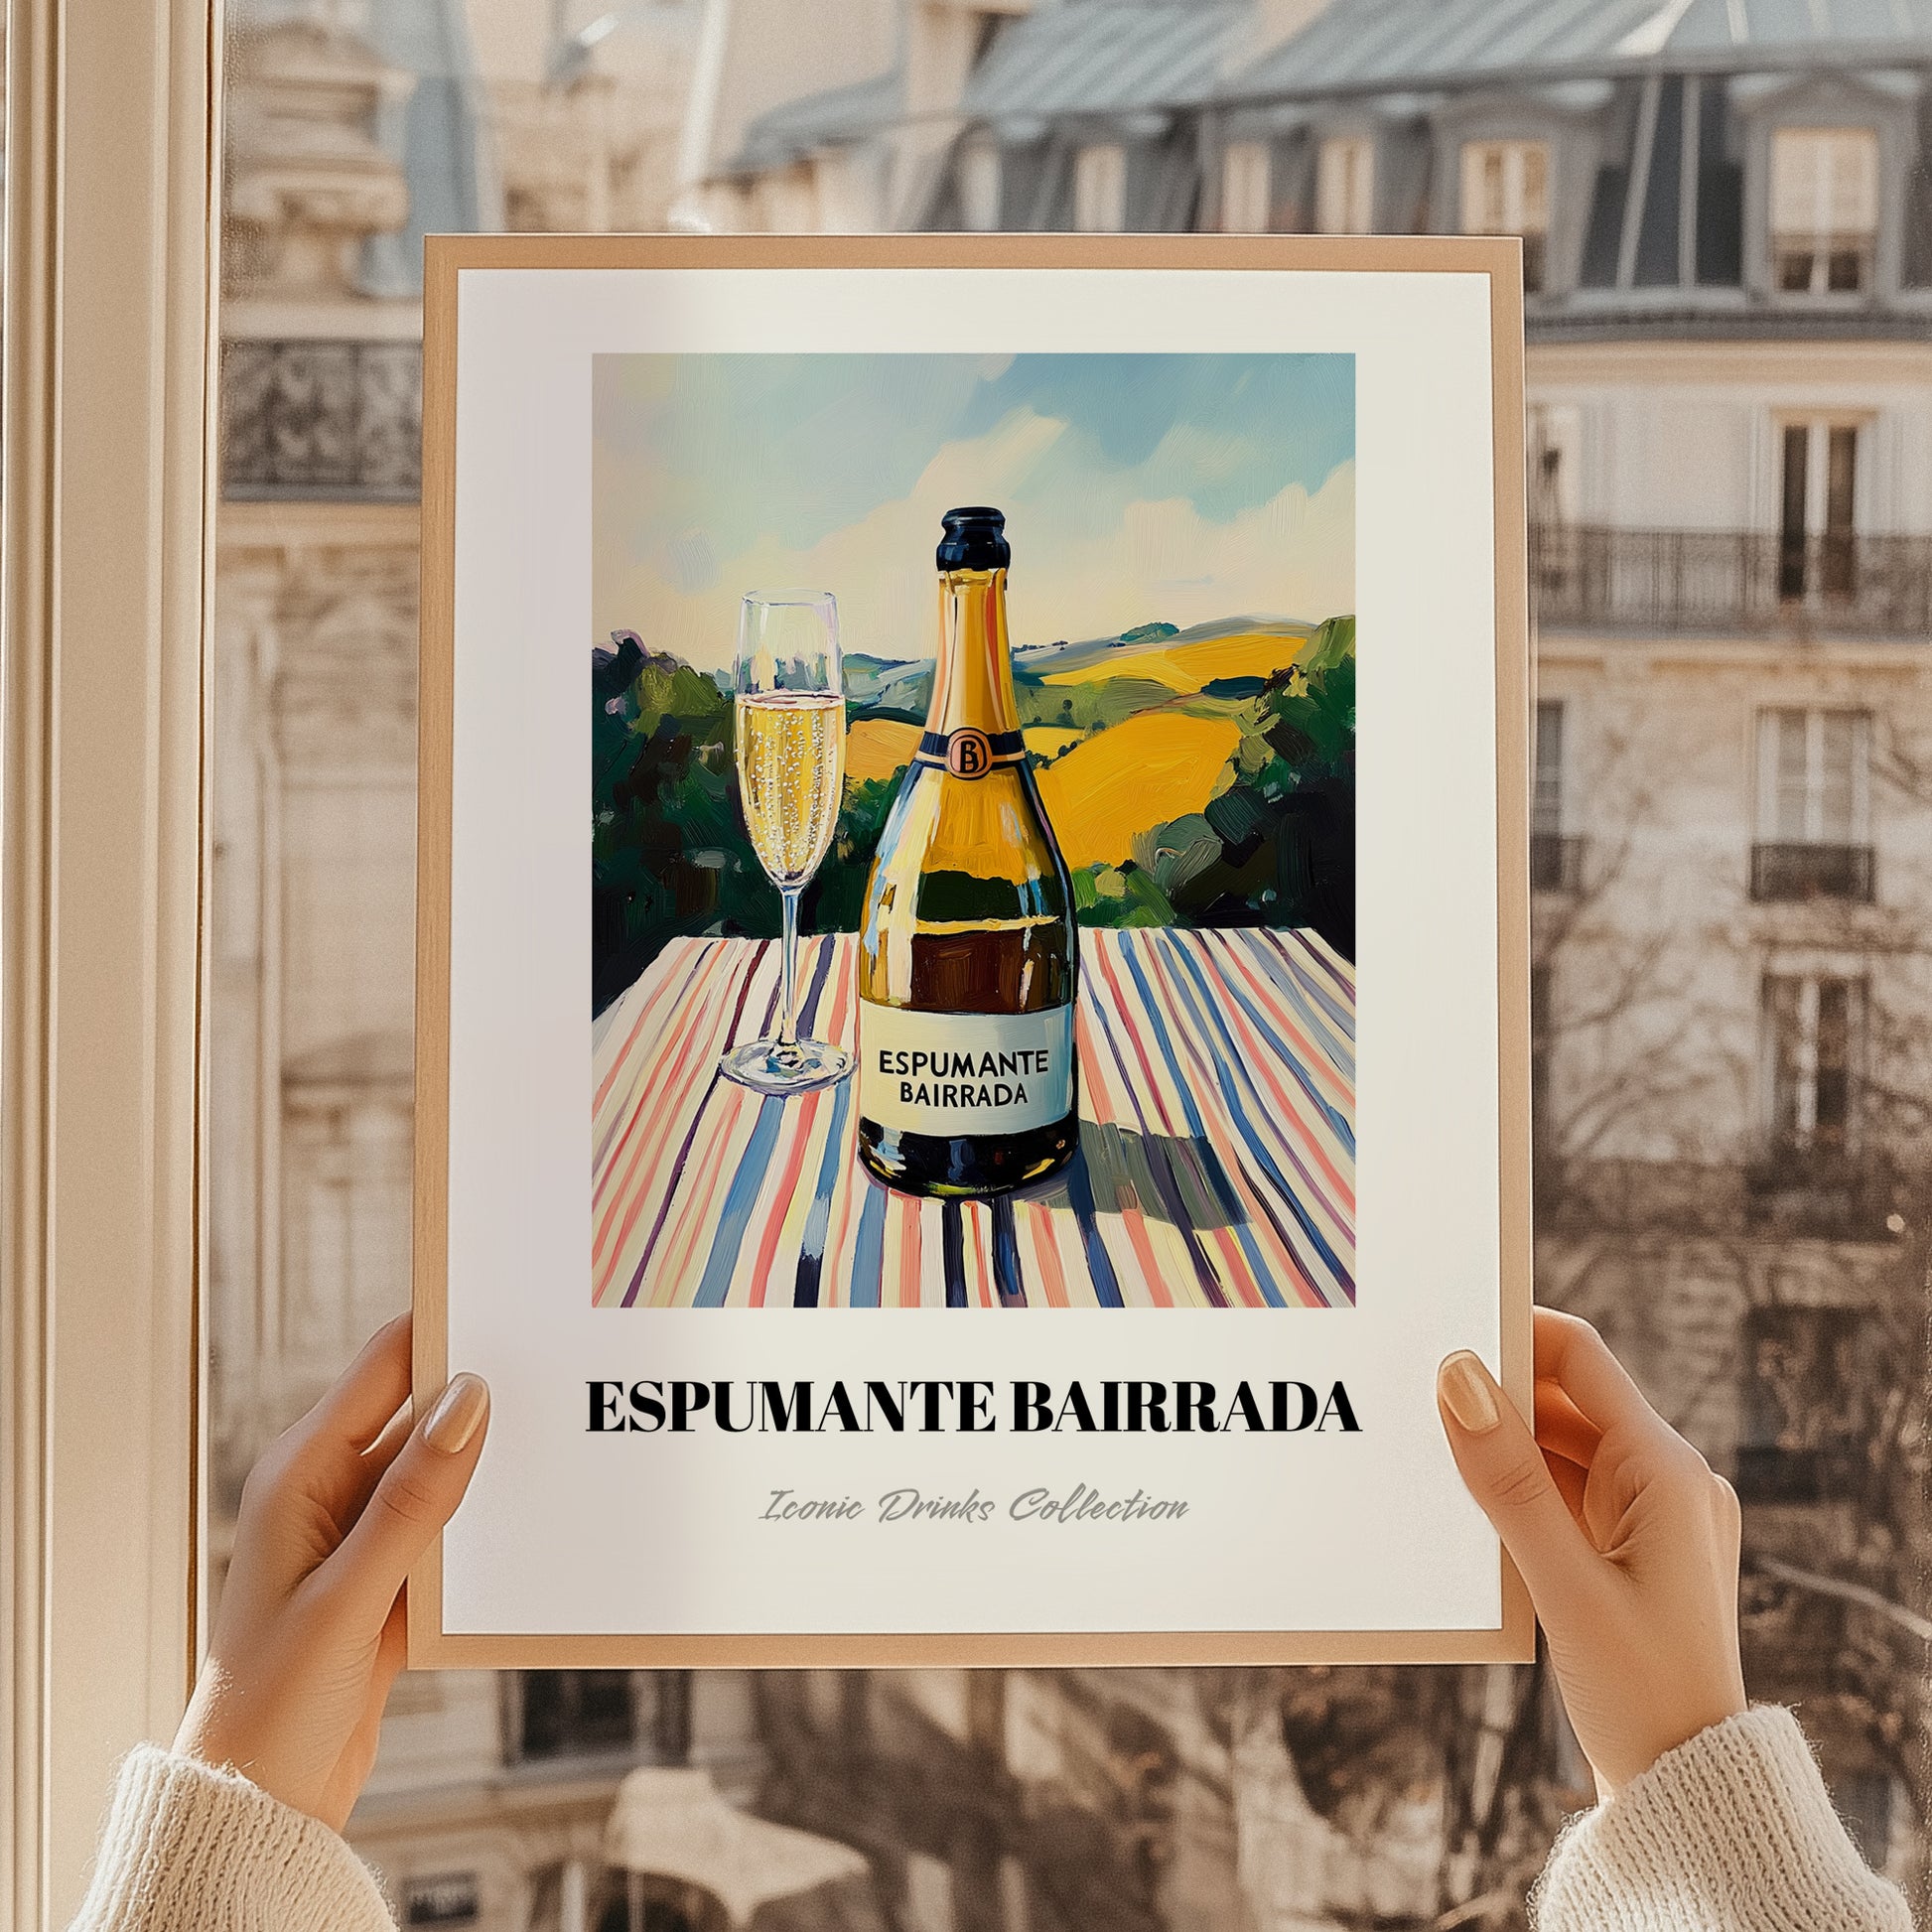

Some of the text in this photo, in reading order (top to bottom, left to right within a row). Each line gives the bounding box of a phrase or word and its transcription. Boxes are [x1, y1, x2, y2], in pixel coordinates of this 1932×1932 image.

[879, 1048, 1049, 1078] ESPUMANTE
[899, 1081, 1029, 1108] BAIRRADA
[585, 1380, 1364, 1433] ESPUMANTE BAIRRADA
[758, 1481, 1190, 1524] Iconic Drinks Collection
